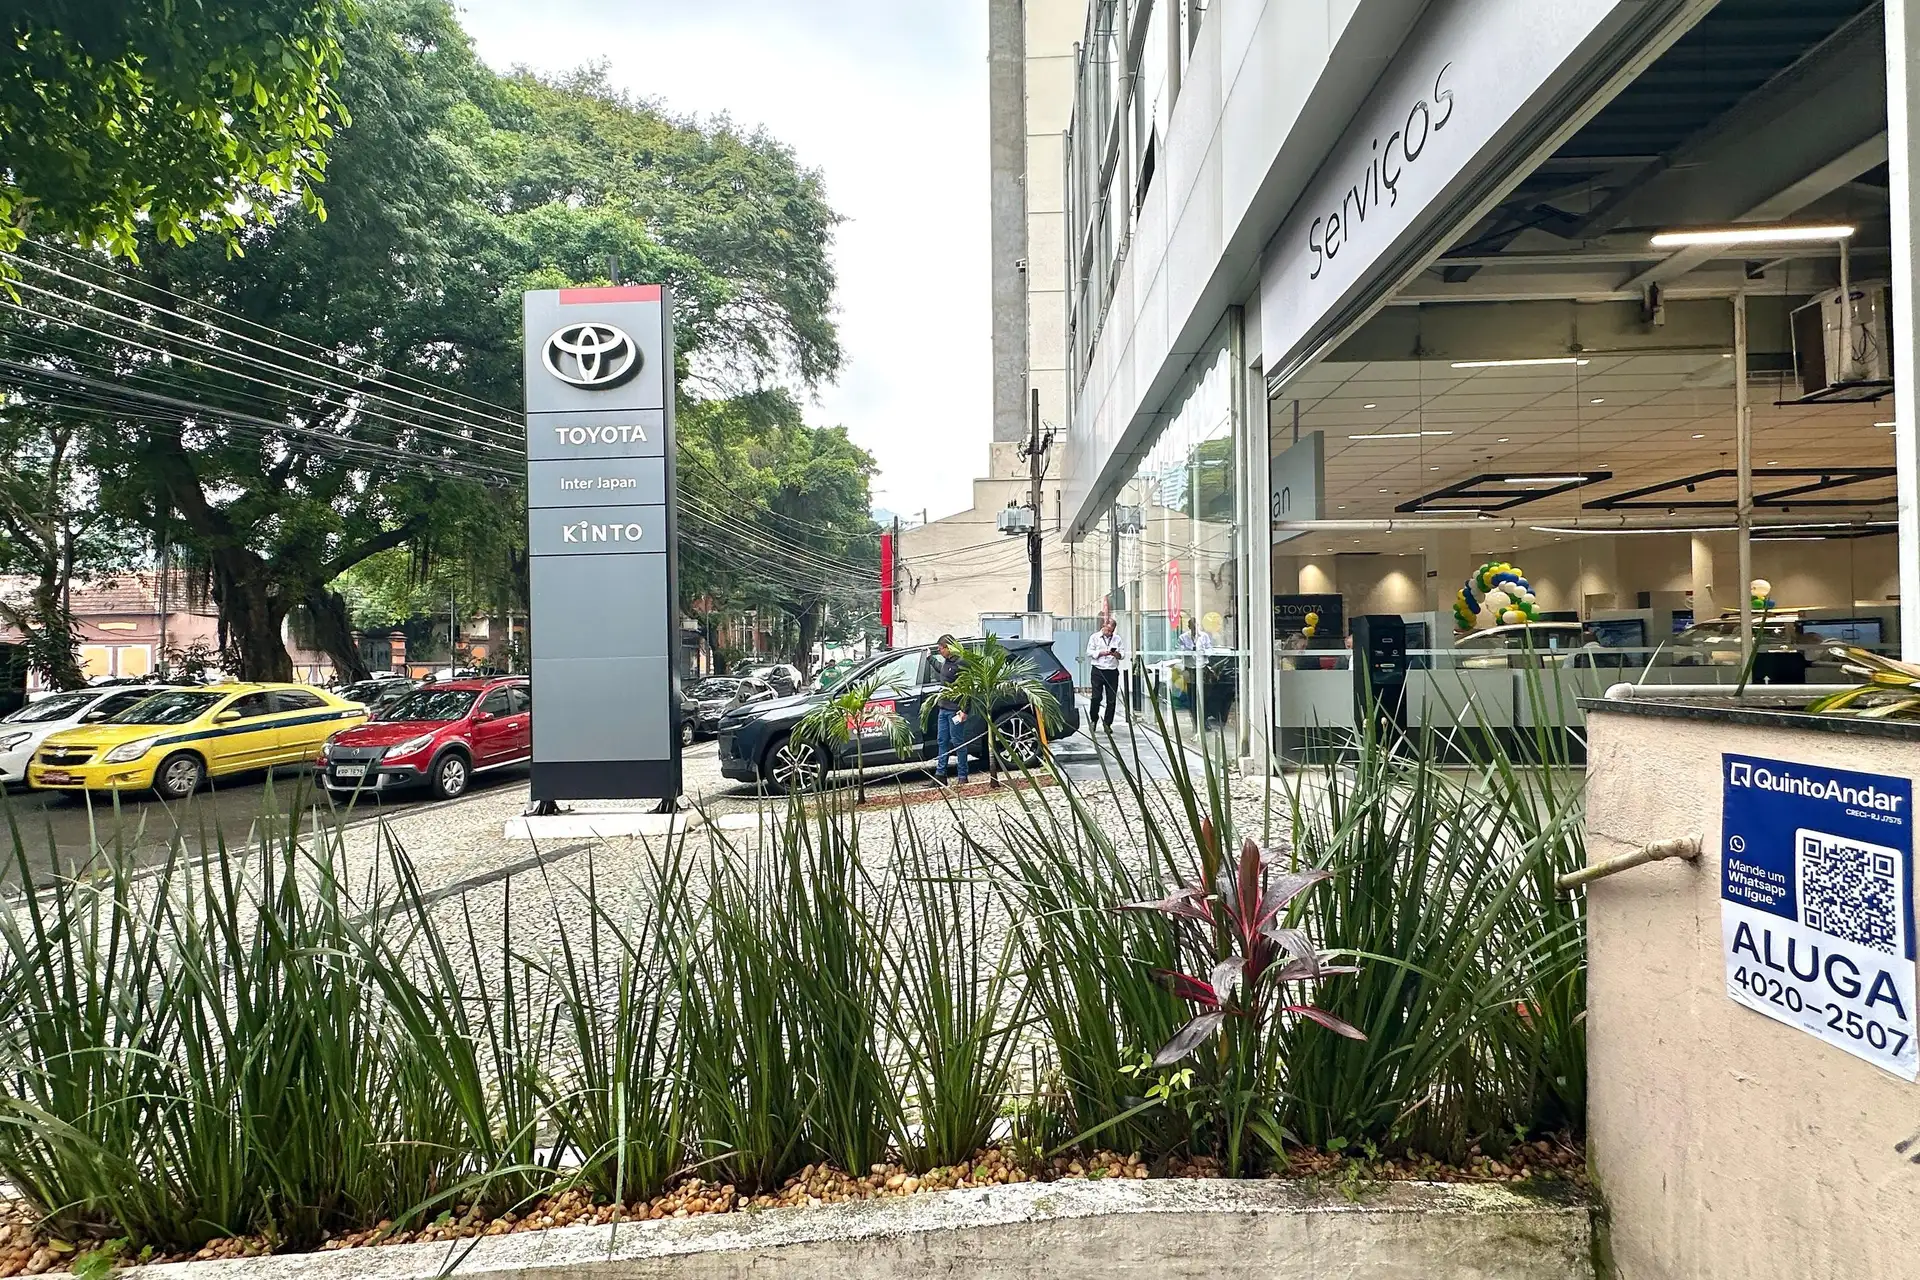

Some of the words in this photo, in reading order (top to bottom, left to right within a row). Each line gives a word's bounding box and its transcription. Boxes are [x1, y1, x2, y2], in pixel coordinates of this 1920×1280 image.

[1310, 61, 1454, 280] Serviços
[555, 425, 647, 445] TOYOTA
[561, 477, 594, 490] Inter
[597, 476, 637, 490] Japan
[1283, 603, 1324, 615] TOYOTA
[1754, 768, 1903, 812] QuintoAndar
[1845, 808, 1880, 821] CRECI-RJ
[1728, 870, 1786, 898] Whatsapp
[1729, 858, 1766, 878] Mande
[1767, 871, 1785, 884] um
[1728, 885, 1742, 896] ou
[1744, 886, 1776, 906] ligue.
[1732, 921, 1908, 1021] ALUGA
[1734, 966, 1909, 1057] 4020-2507
